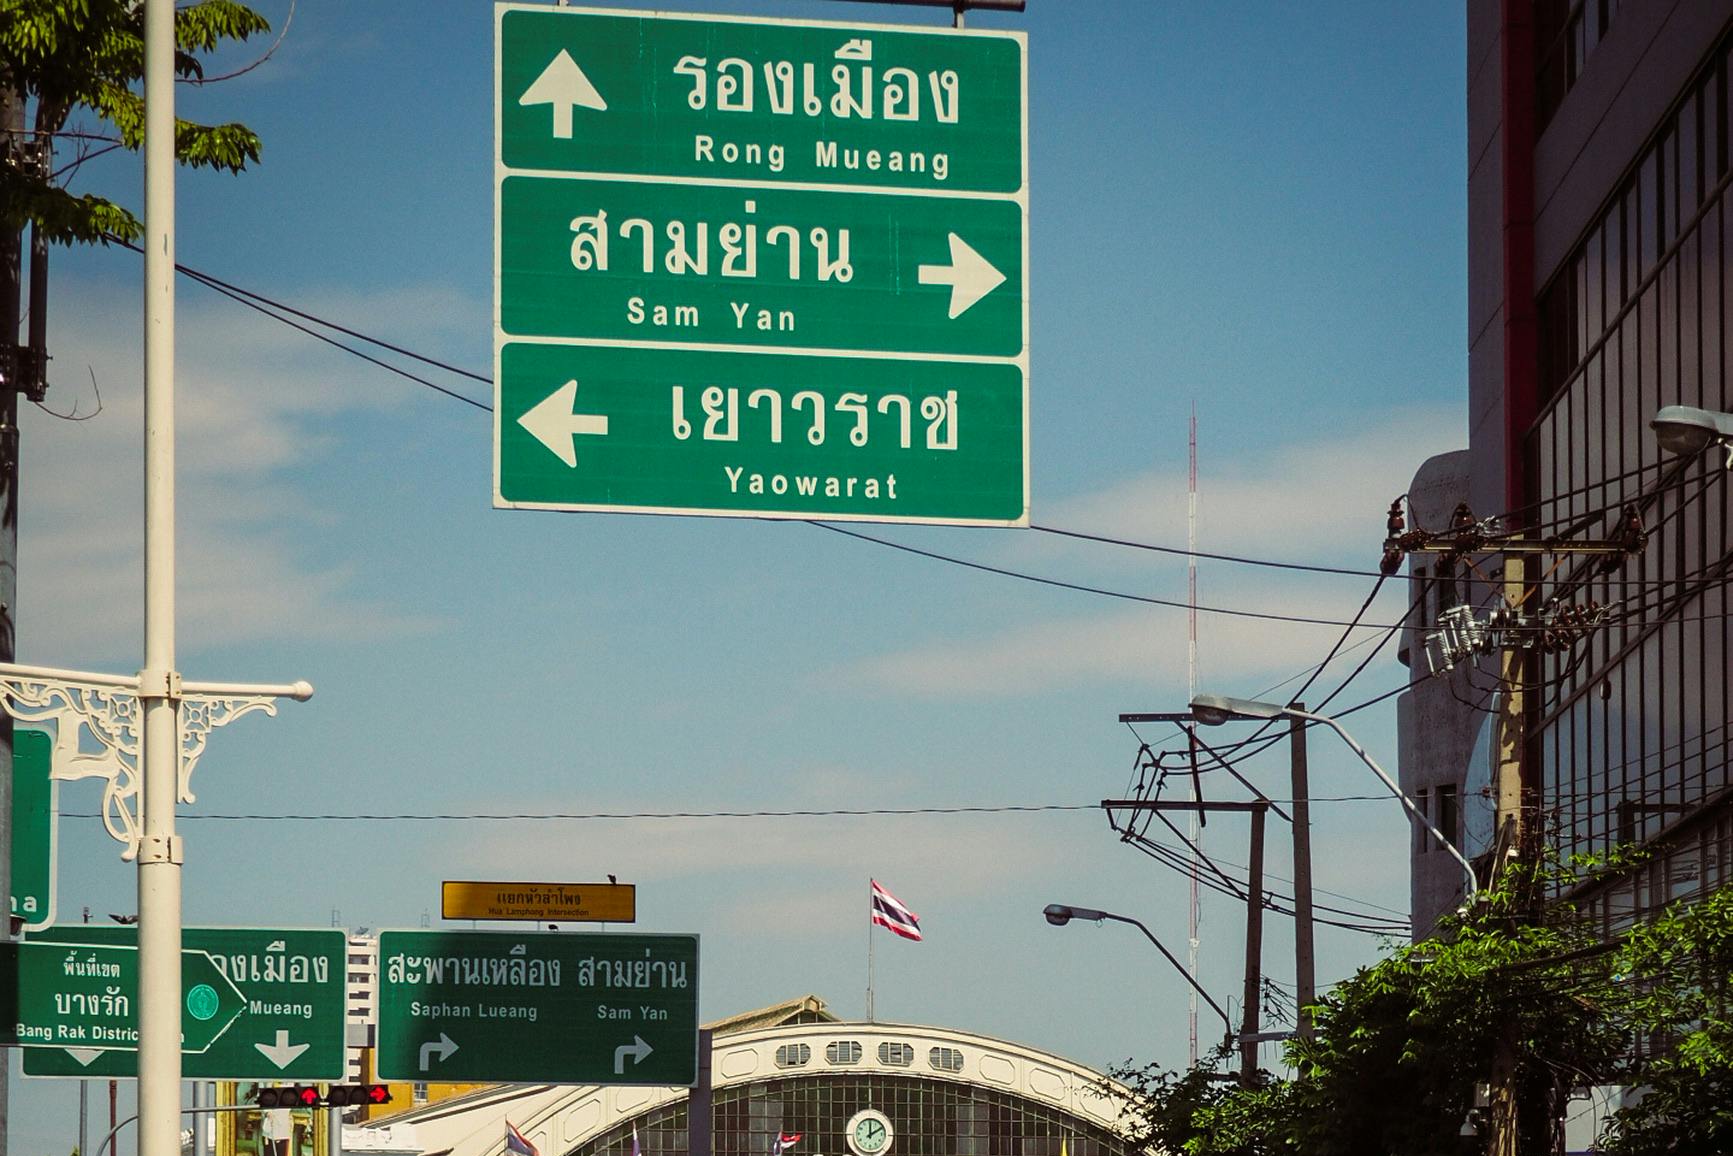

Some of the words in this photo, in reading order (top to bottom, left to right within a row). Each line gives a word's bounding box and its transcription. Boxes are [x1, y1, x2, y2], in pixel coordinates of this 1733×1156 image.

[673, 38, 960, 124] รองเมือง
[695, 135, 786, 172] Rong
[815, 141, 950, 180] Mueang
[568, 200, 855, 283] สามย่าน
[626, 297, 700, 327] Sam
[730, 302, 796, 332] Yan
[671, 384, 959, 452] เยาวราช
[725, 466, 898, 501] Yaowarat
[63, 949, 121, 978] พื้นที่เขต
[388, 944, 561, 986] สะพานเหลือง
[578, 948, 688, 989] สามย่าน
[55, 986, 129, 1017] บางรัก
[249, 1000, 313, 1018] Mueang
[410, 1001, 471, 1019] Saphan
[478, 1002, 538, 1022] Lueang
[597, 1004, 632, 1020] Sam
[639, 1005, 668, 1021] Yan
[16, 1023, 53, 1041] Bang
[58, 1025, 86, 1039] Rak
[92, 1026, 139, 1041] Distric
